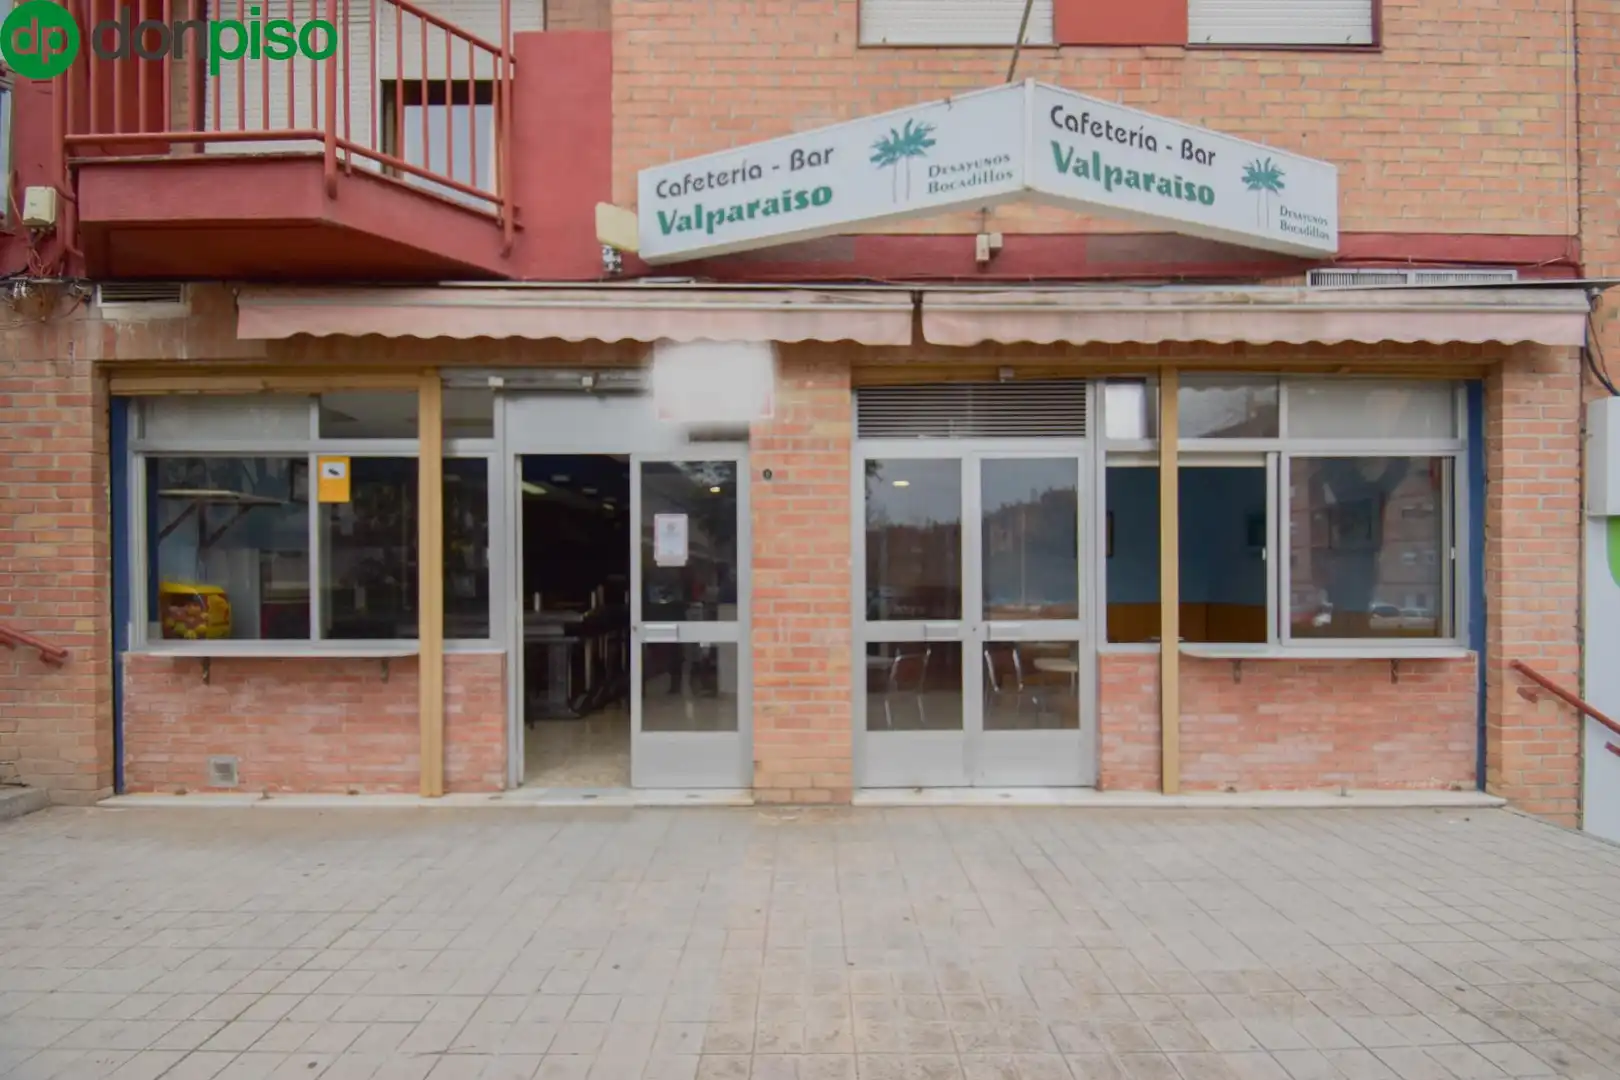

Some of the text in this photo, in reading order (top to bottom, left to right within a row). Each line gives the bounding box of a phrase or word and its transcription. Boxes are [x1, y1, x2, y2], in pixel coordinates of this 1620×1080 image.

[1050, 104, 1158, 153] Cafetería
[1181, 138, 1216, 166] Bar
[656, 158, 762, 199] Cafetería
[790, 148, 834, 171] Bar
